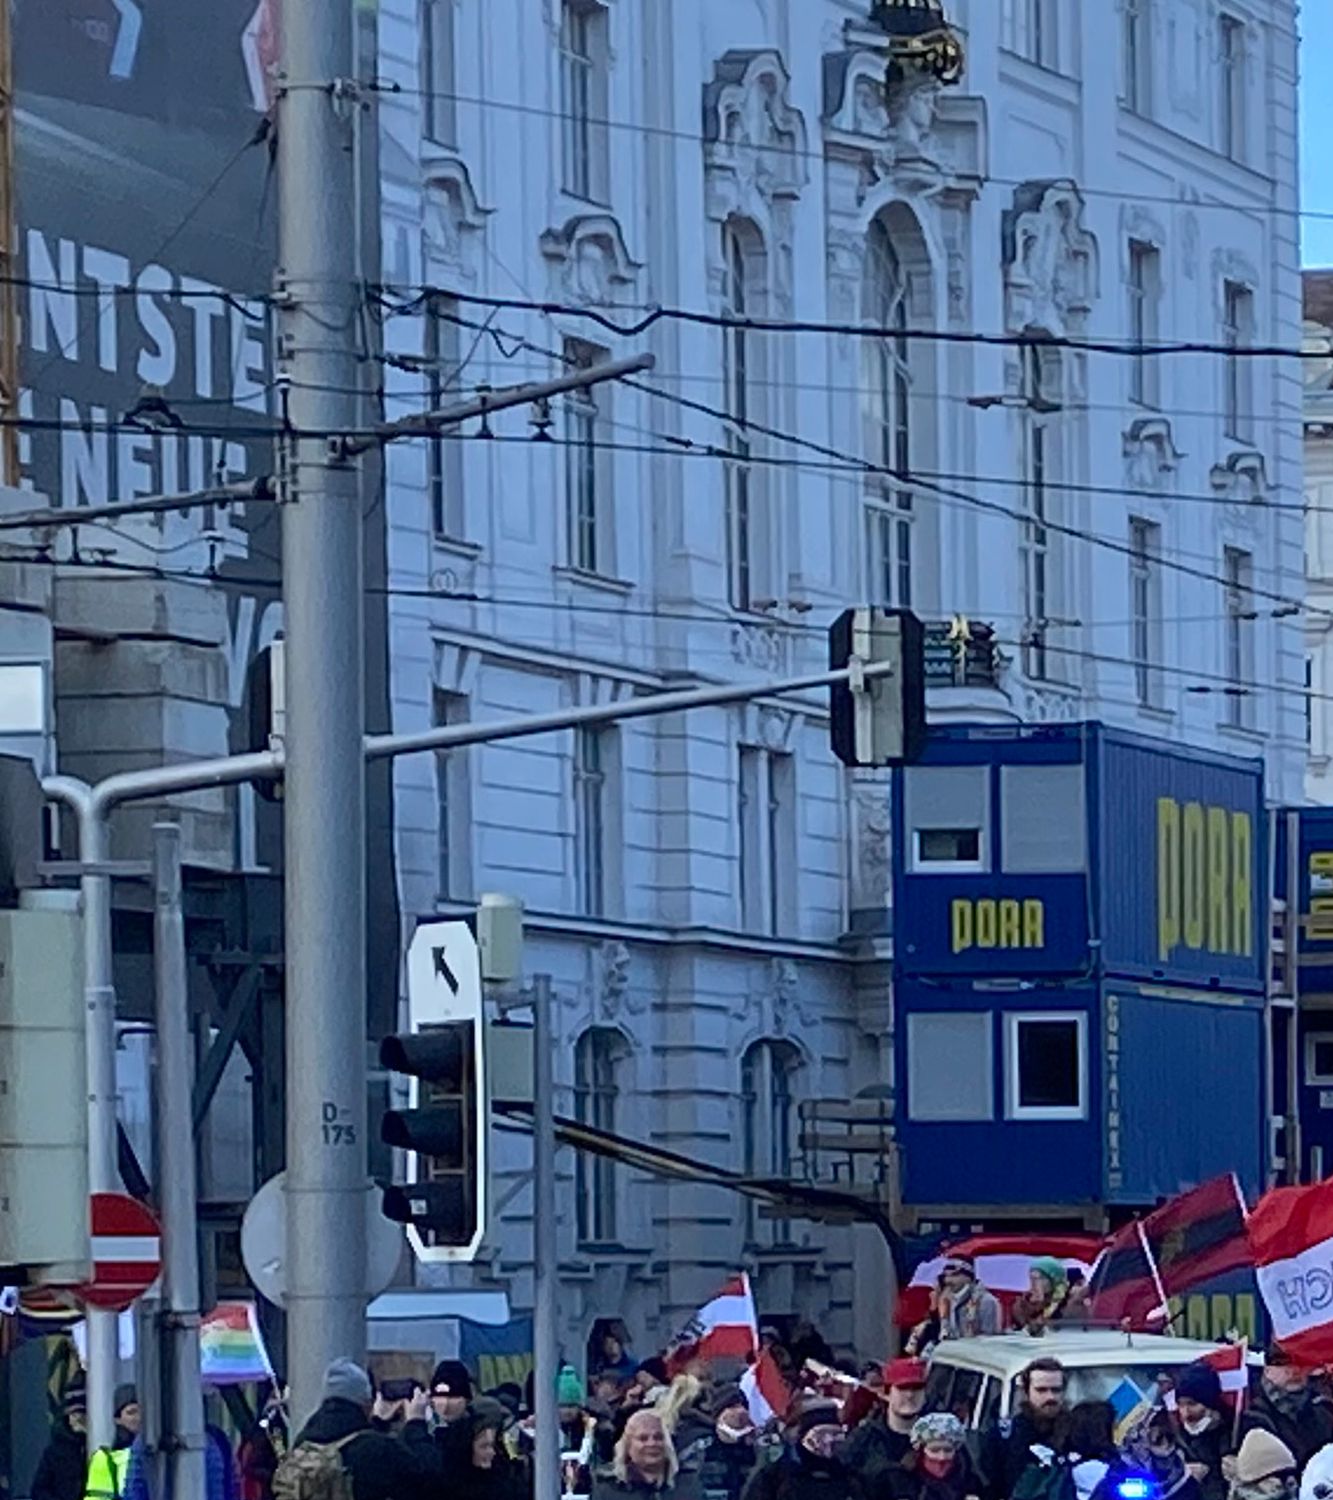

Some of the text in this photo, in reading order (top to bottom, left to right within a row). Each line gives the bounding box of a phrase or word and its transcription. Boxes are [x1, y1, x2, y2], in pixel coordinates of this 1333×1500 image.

[13, 225, 283, 416] NTSTE
[952, 899, 1044, 954] PORR
[1157, 797, 1251, 961] PORR
[322, 1125, 356, 1145] 175
